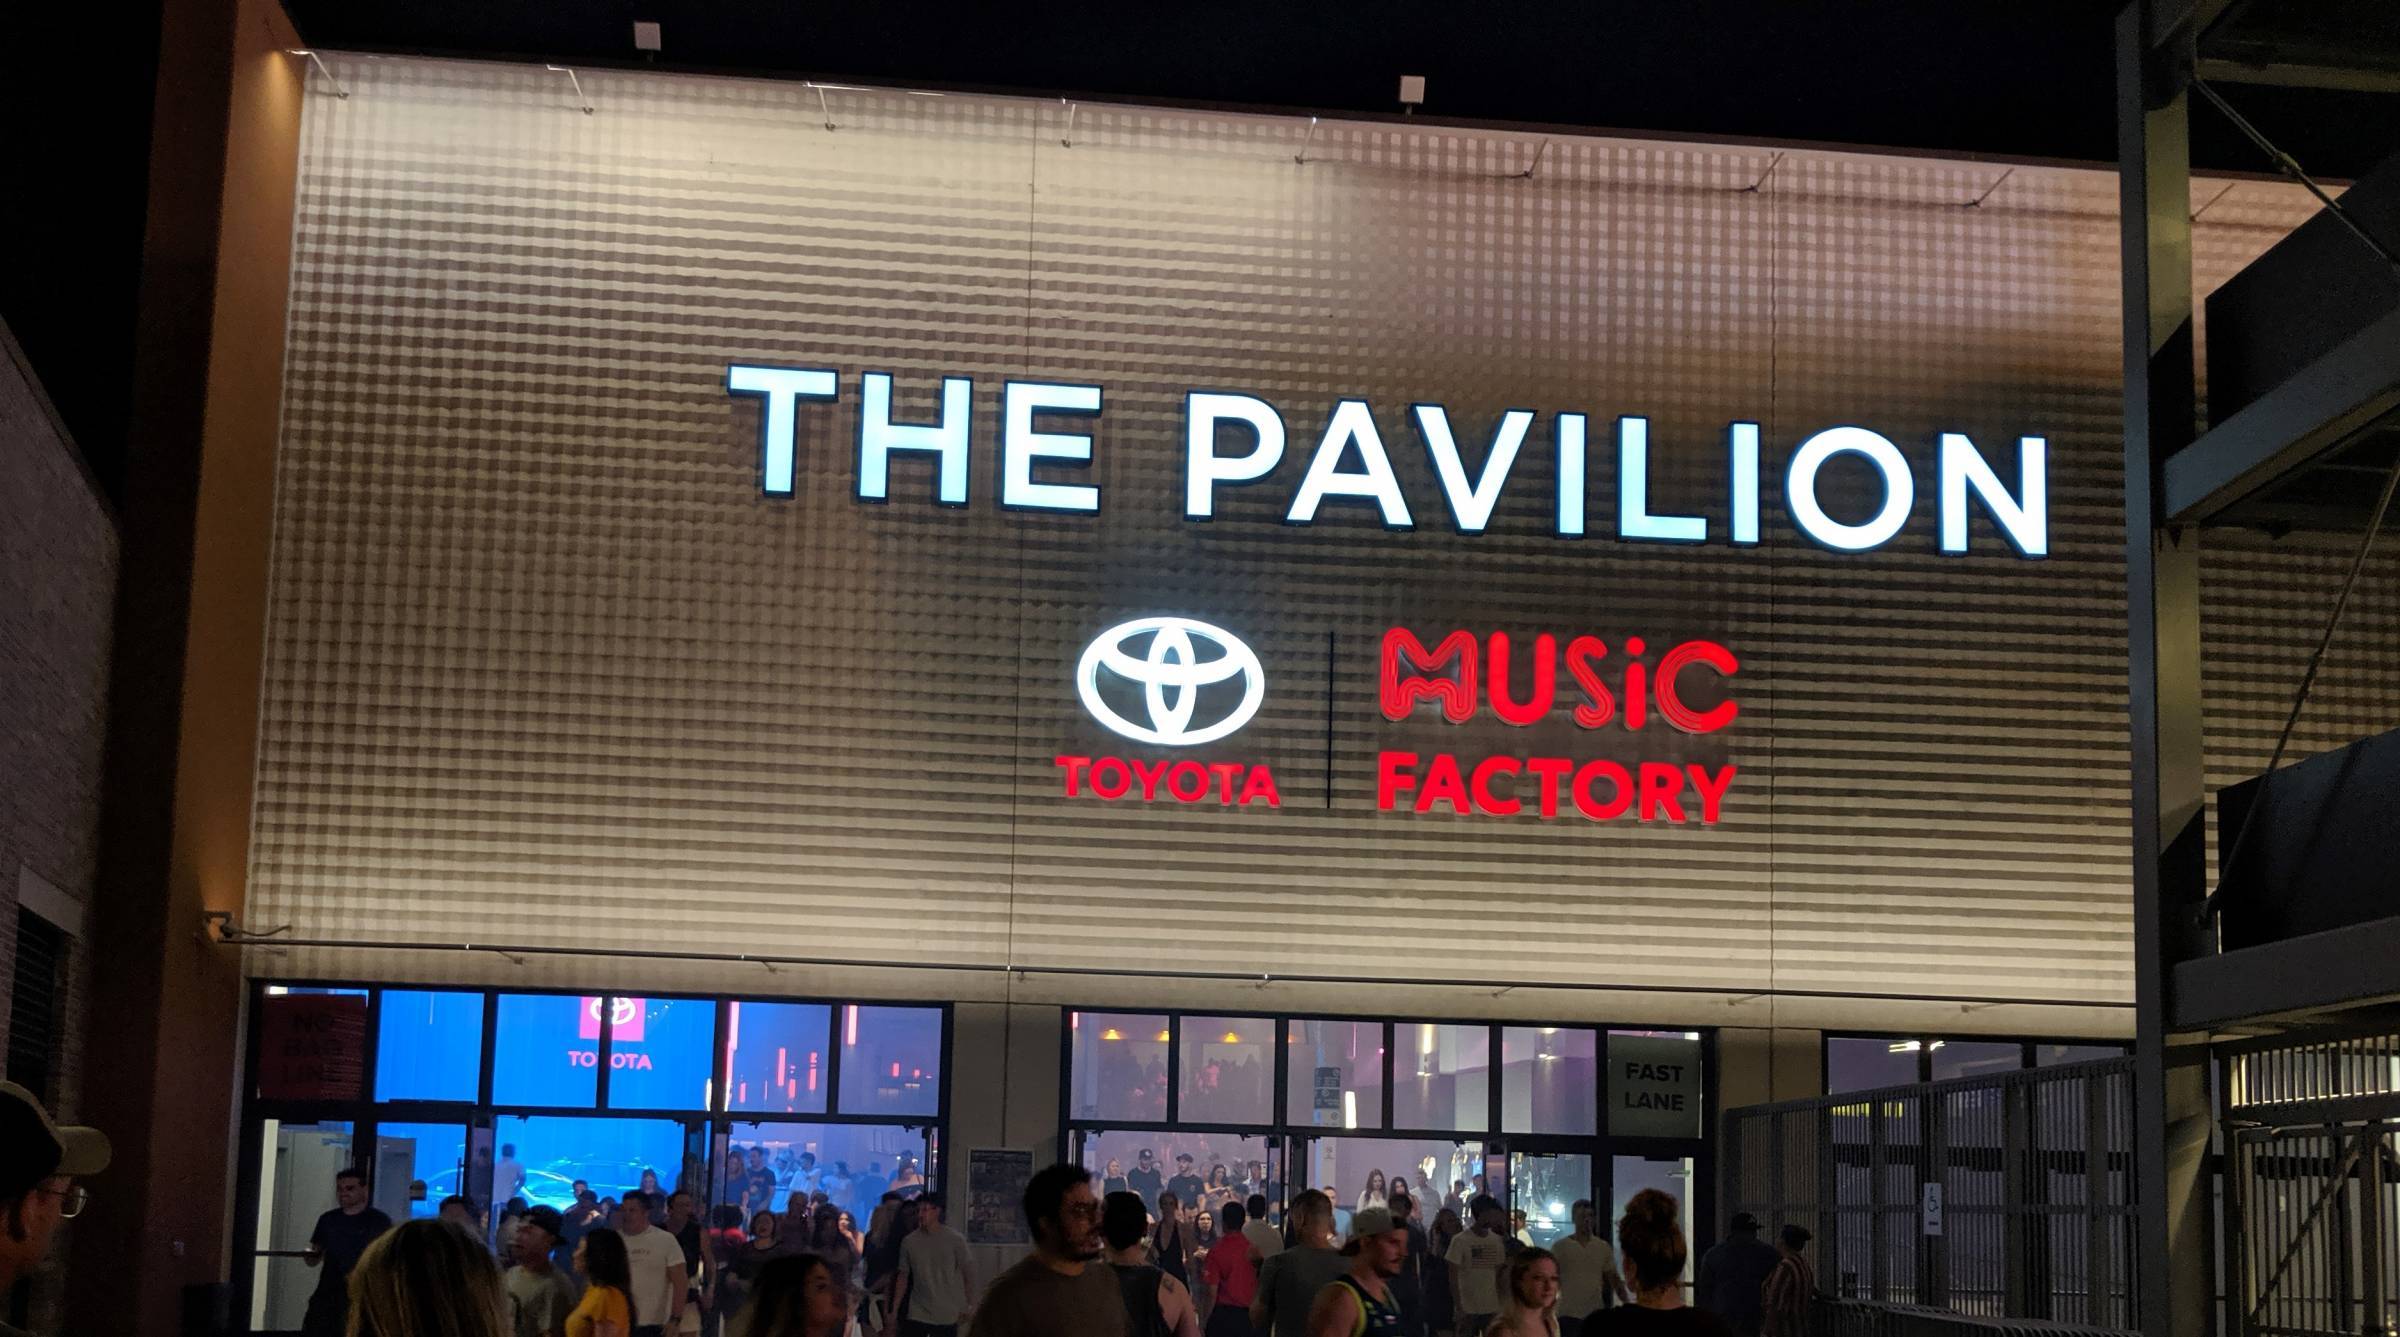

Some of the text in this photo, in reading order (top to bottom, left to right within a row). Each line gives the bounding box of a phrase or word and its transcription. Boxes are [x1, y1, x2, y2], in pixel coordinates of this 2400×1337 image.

[727, 363, 2049, 559] THE PAVILION
[1055, 755, 1280, 808] TOYOTA
[1378, 750, 1738, 825] FACTORY
[568, 1050, 652, 1070] TOOTA
[1626, 1062, 1684, 1082] FAST
[1624, 1091, 1684, 1111] LANE
